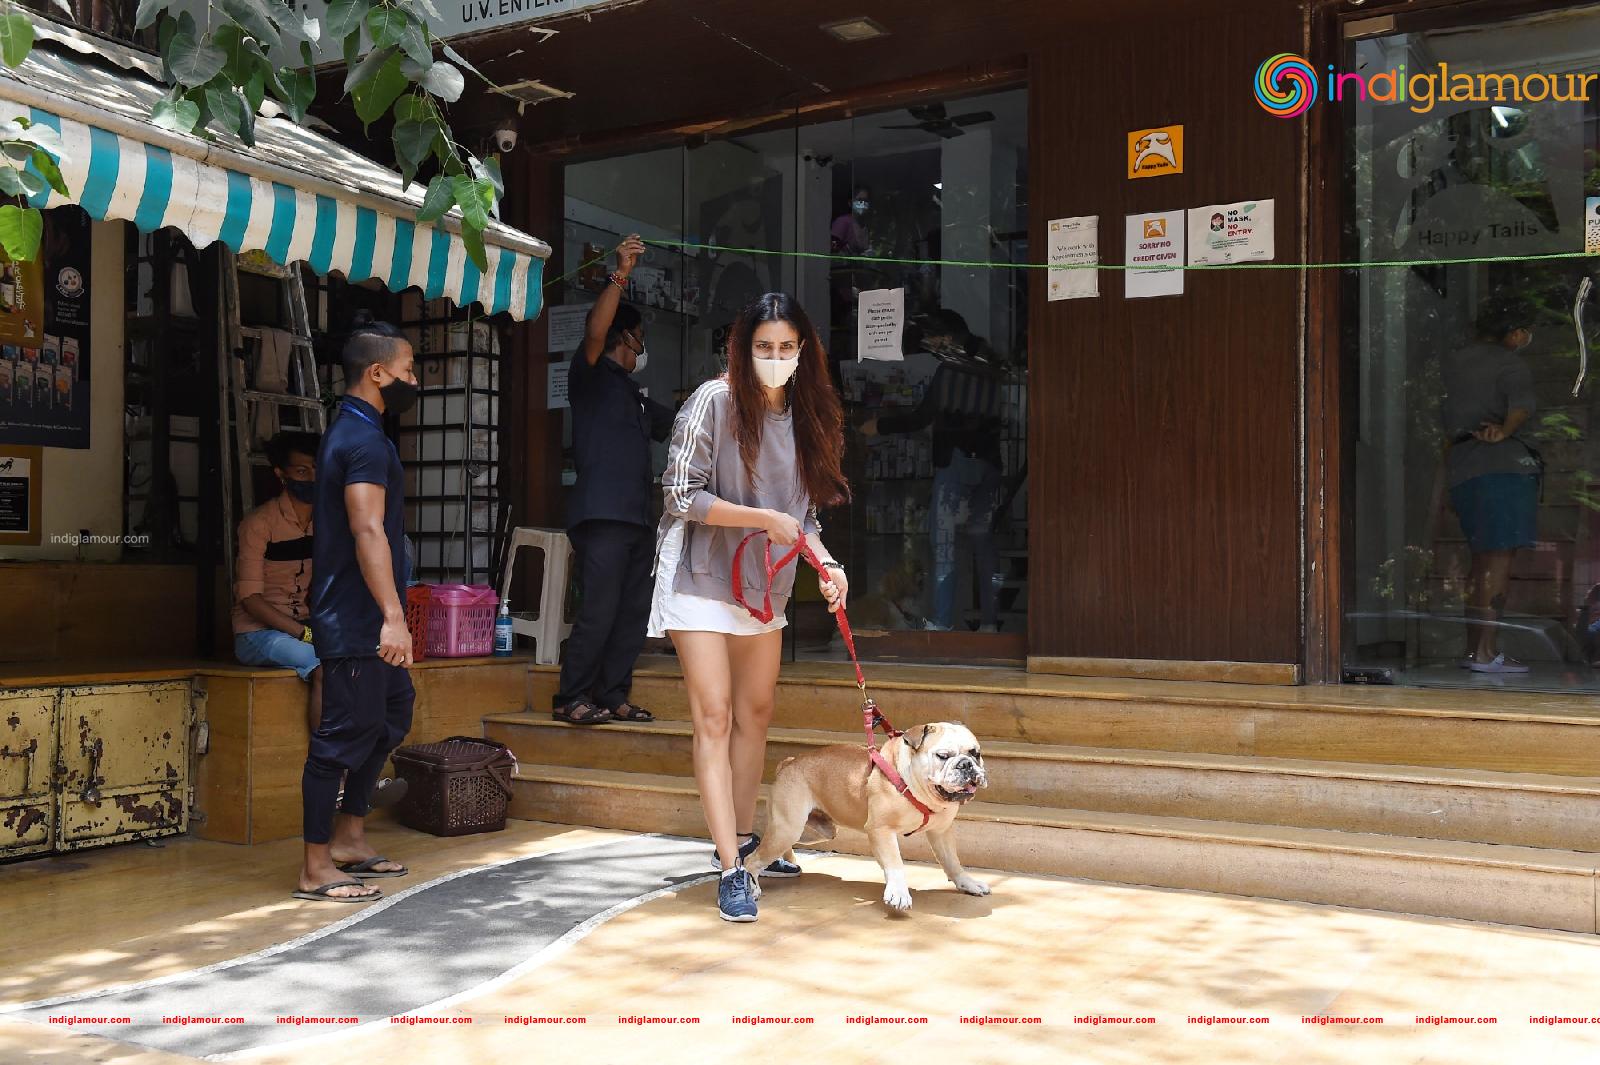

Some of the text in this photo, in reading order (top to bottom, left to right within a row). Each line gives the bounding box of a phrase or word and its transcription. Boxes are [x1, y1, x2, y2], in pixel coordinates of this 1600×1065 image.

[462, 0, 493, 22] U.V.
[1418, 220, 1538, 247] Happy Tails
[1139, 240, 1171, 250] SORRY NO
[1133, 252, 1177, 262] CREDIT GIVEN
